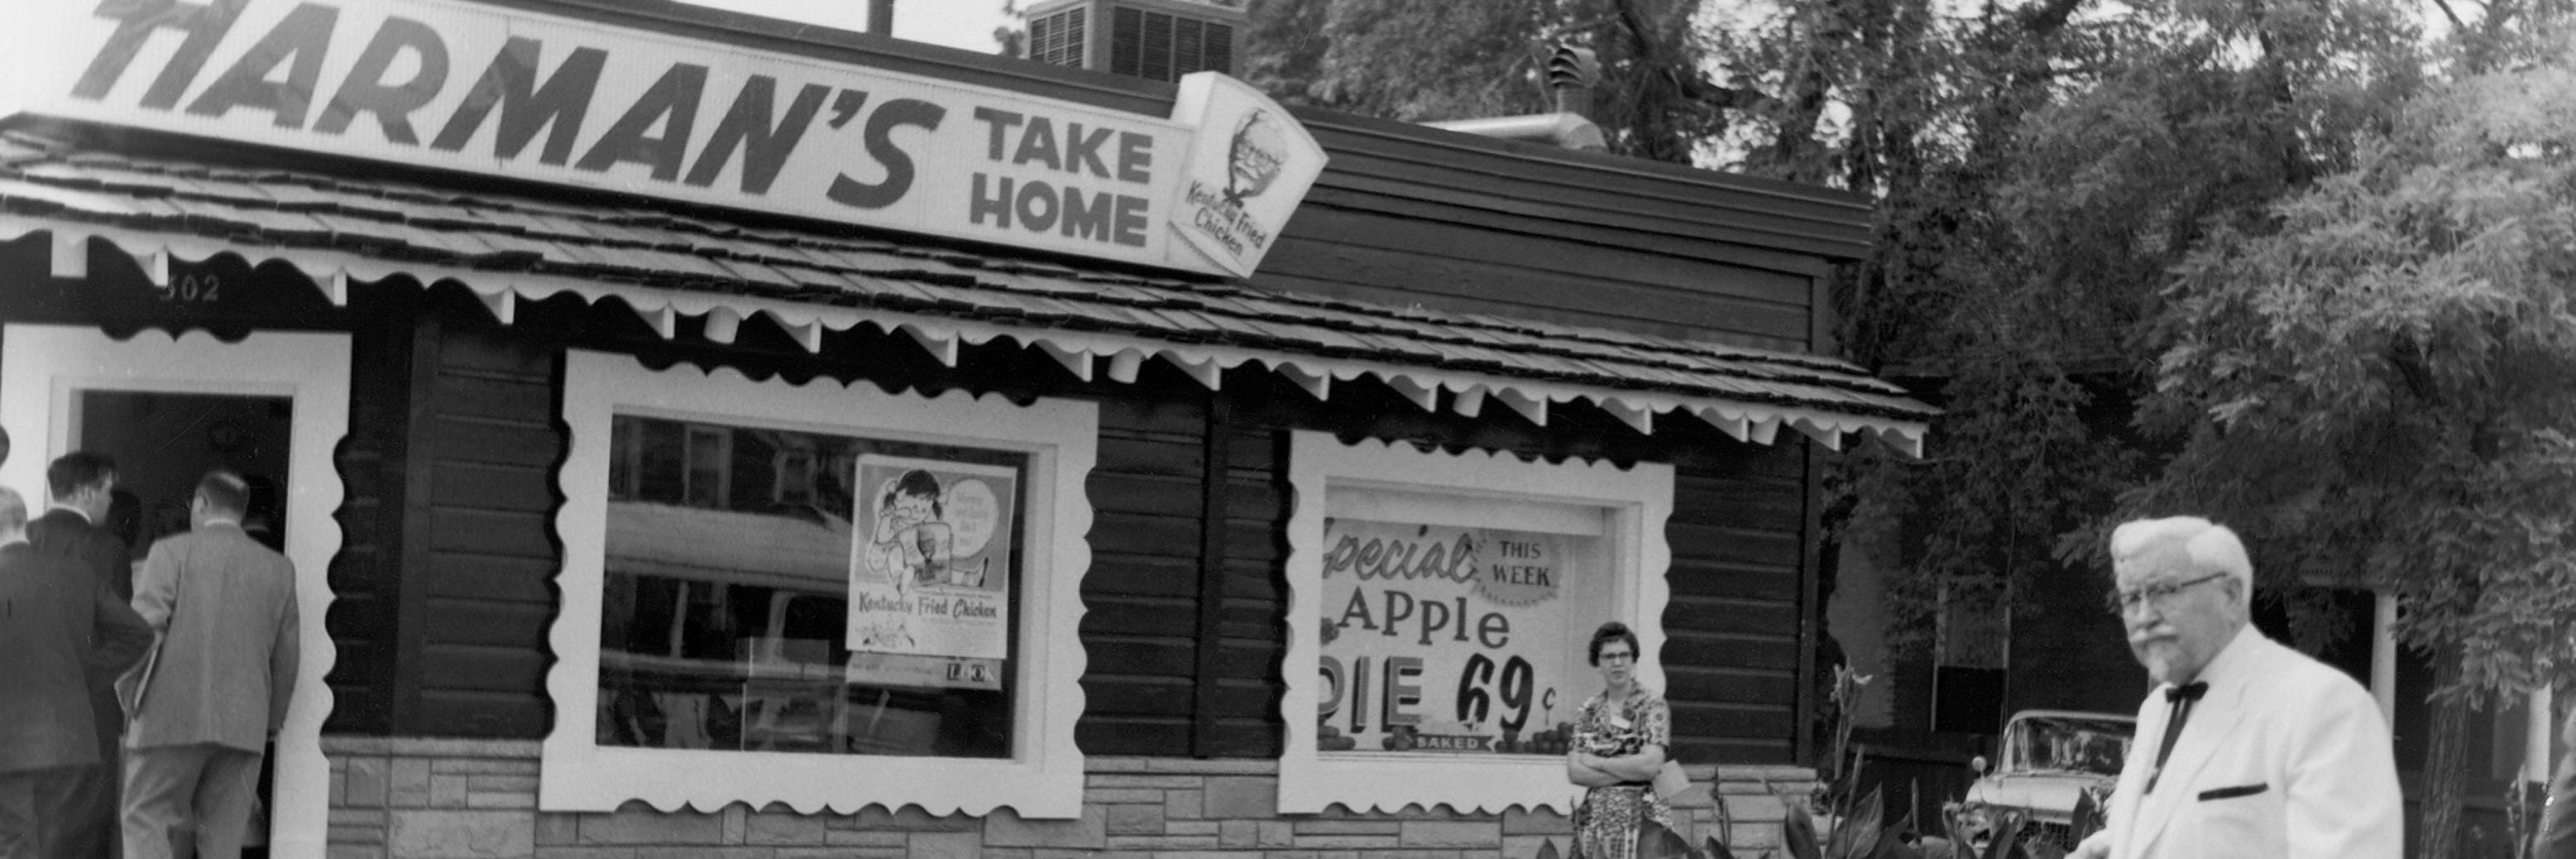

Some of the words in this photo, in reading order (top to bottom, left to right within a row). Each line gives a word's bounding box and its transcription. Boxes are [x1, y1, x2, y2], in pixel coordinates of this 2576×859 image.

[69, 0, 946, 209] HARMAN'S
[973, 105, 1153, 185] TAKE
[970, 171, 1149, 247] HOME
[1185, 179, 1238, 226] Kentucky
[1234, 210, 1268, 250] Fried
[1194, 206, 1245, 257] Chicken
[1322, 518, 1482, 583] pecial
[1491, 564, 1550, 588] WEEK
[1498, 540, 1541, 560] THIS
[859, 591, 913, 615] Kentucky
[918, 596, 949, 617] Fried
[953, 597, 998, 619] Chicken
[1417, 737, 1479, 750] BAKED
